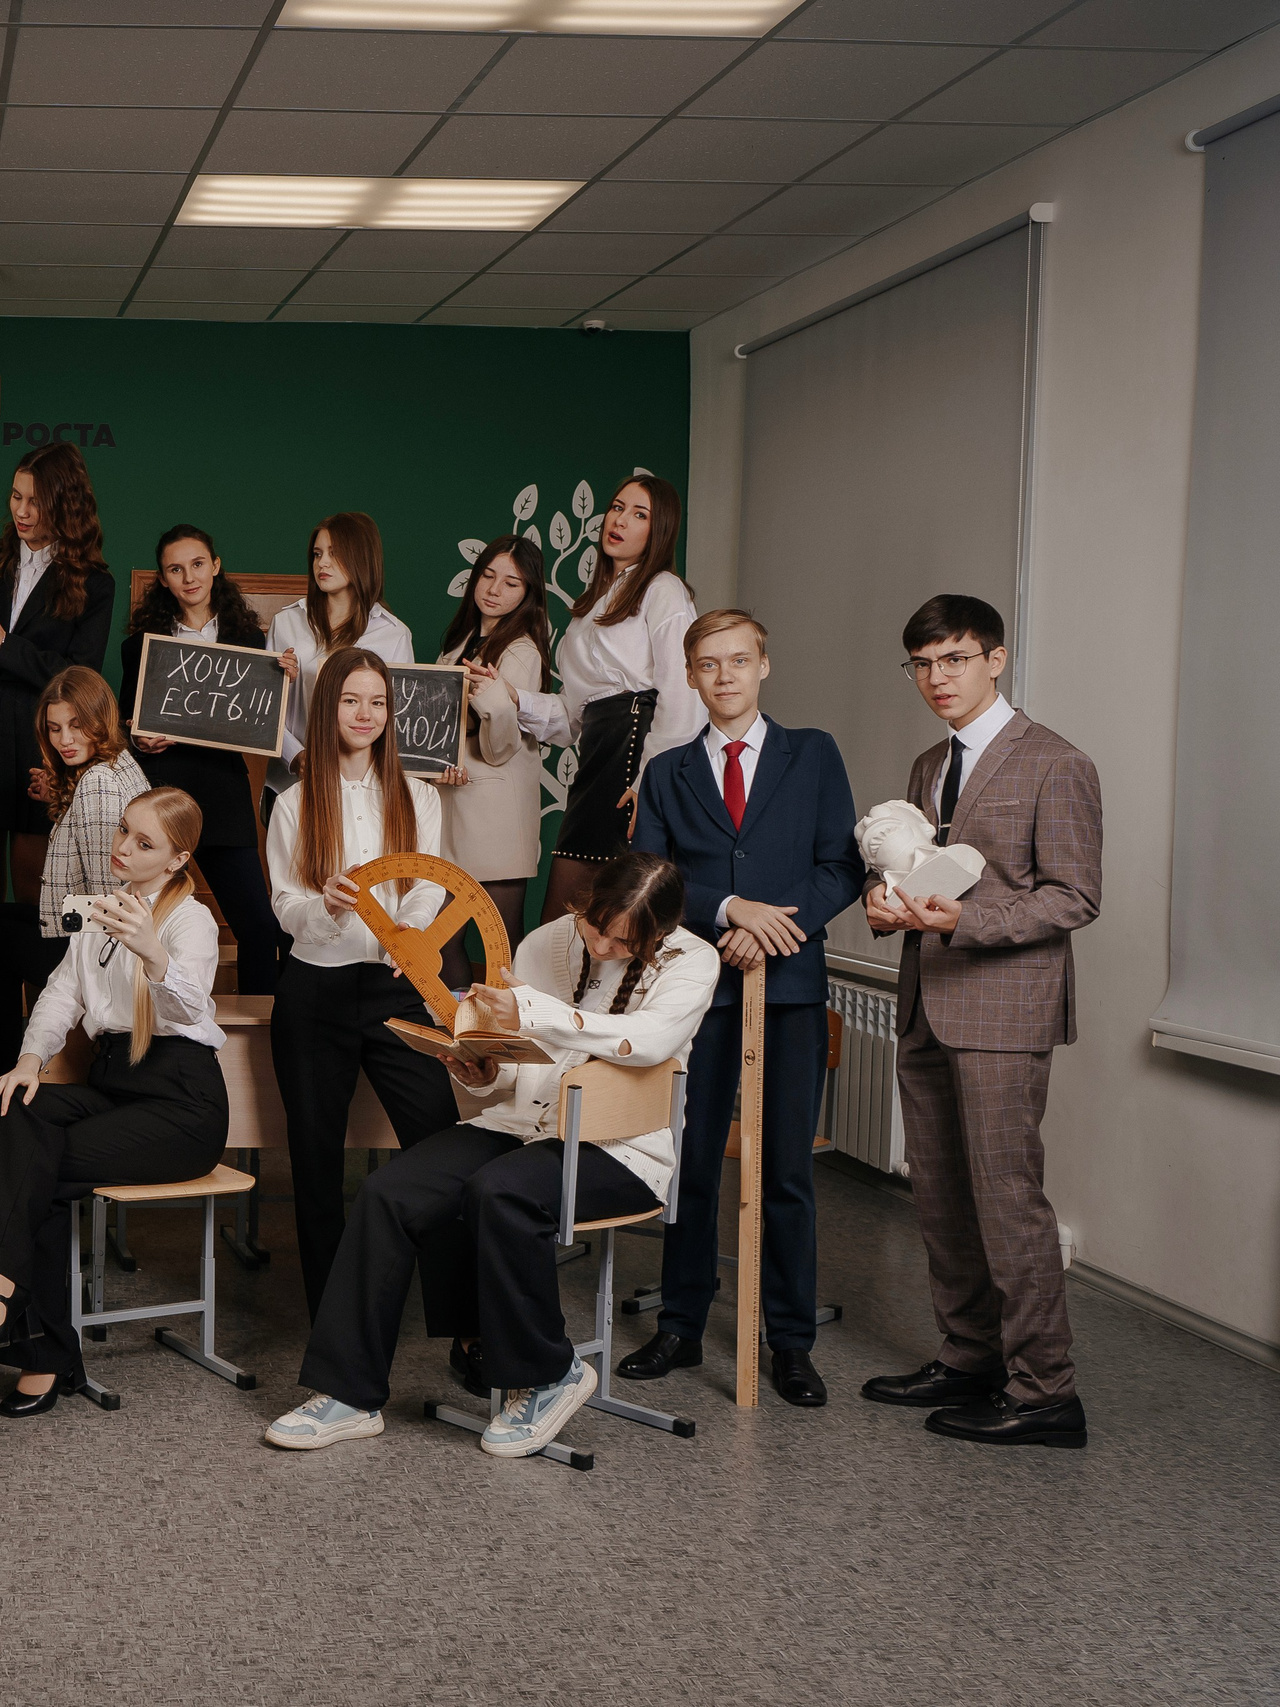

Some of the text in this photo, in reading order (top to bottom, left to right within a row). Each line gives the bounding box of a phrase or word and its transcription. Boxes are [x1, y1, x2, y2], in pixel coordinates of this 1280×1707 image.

[2, 421, 117, 448] РОСТА
[167, 648, 252, 688] ХОЧУ
[394, 701, 460, 759] МОЙ!
